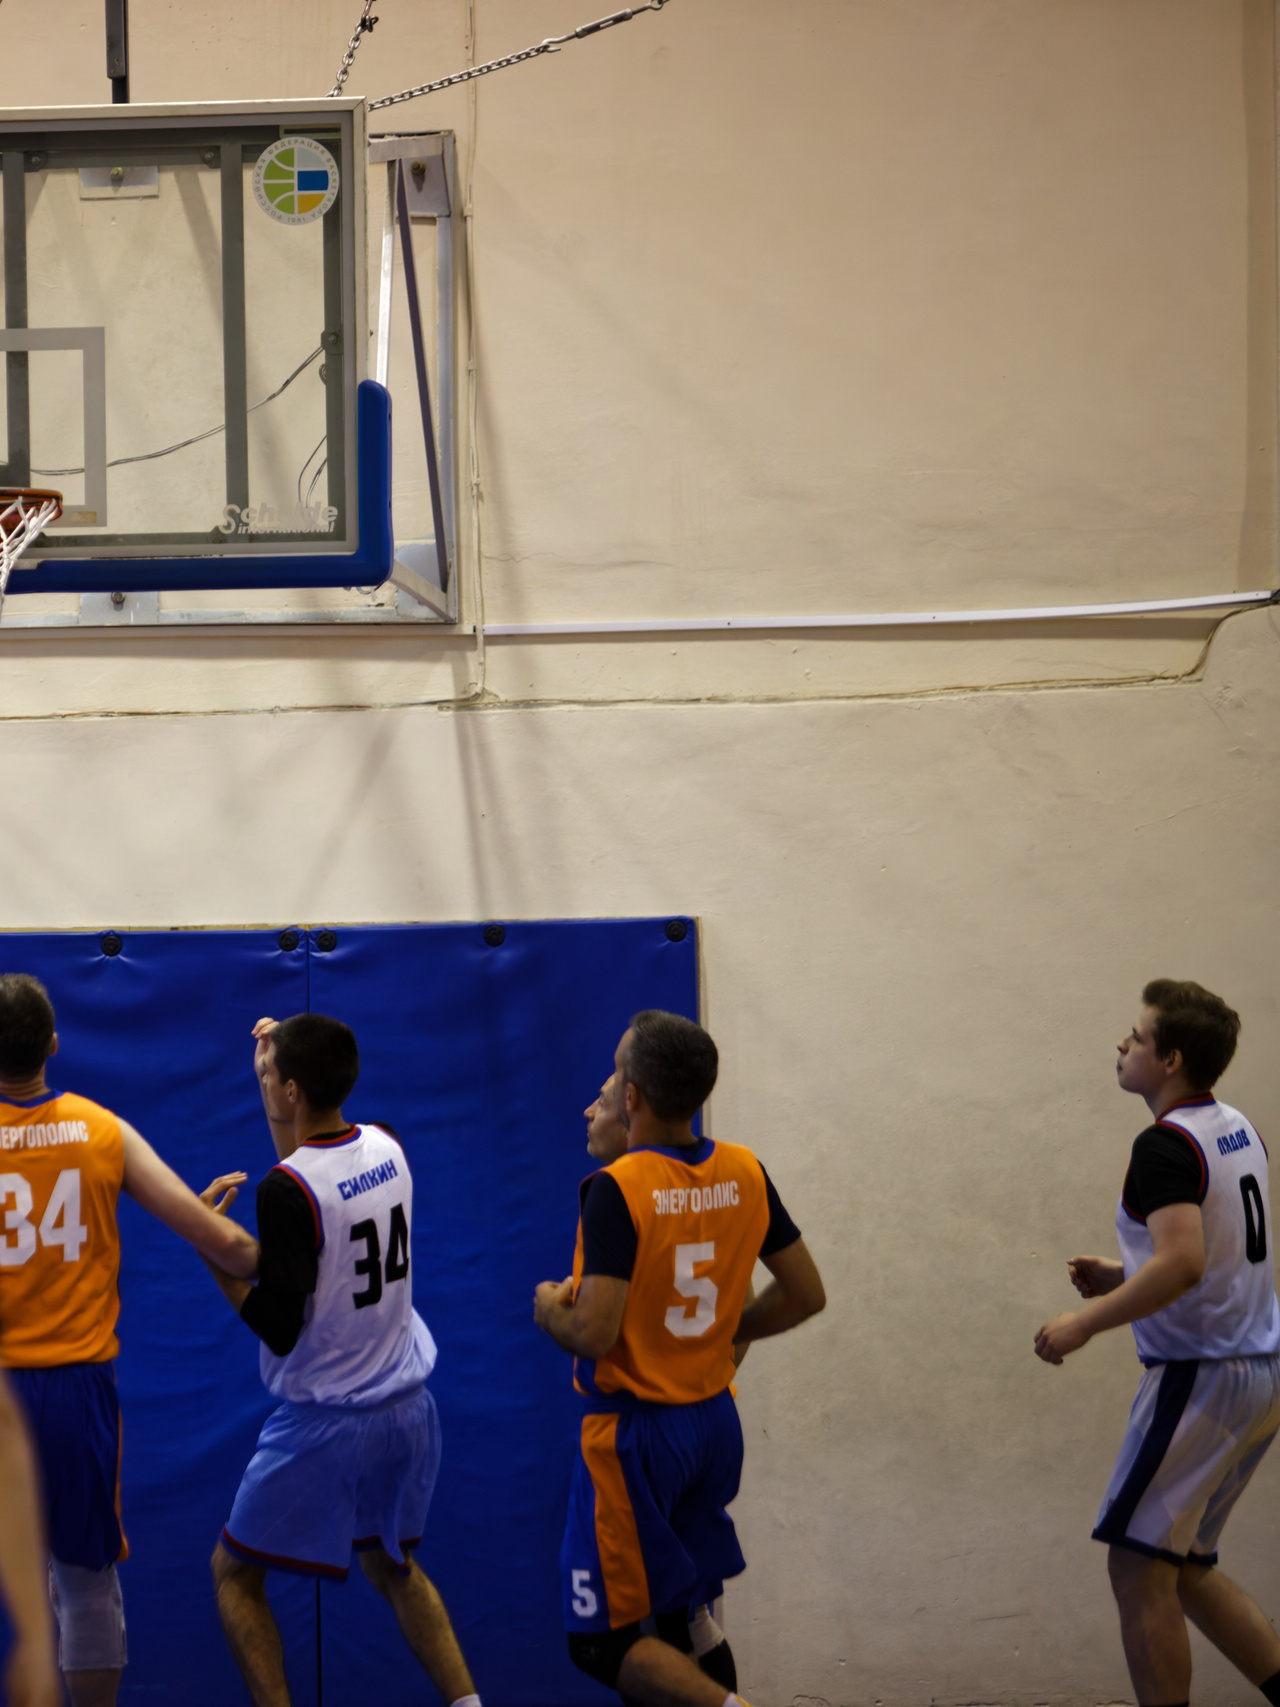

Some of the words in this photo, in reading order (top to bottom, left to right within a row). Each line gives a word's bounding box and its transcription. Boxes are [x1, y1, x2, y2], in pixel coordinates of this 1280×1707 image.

[268, 139, 325, 155] ФЕДЕРАЦИЯ
[337, 1158, 398, 1201] СИЛКИН
[1239, 1173, 1267, 1264] 0
[349, 1202, 409, 1310] 34
[664, 1240, 718, 1338] 5
[571, 1569, 598, 1617] 5
